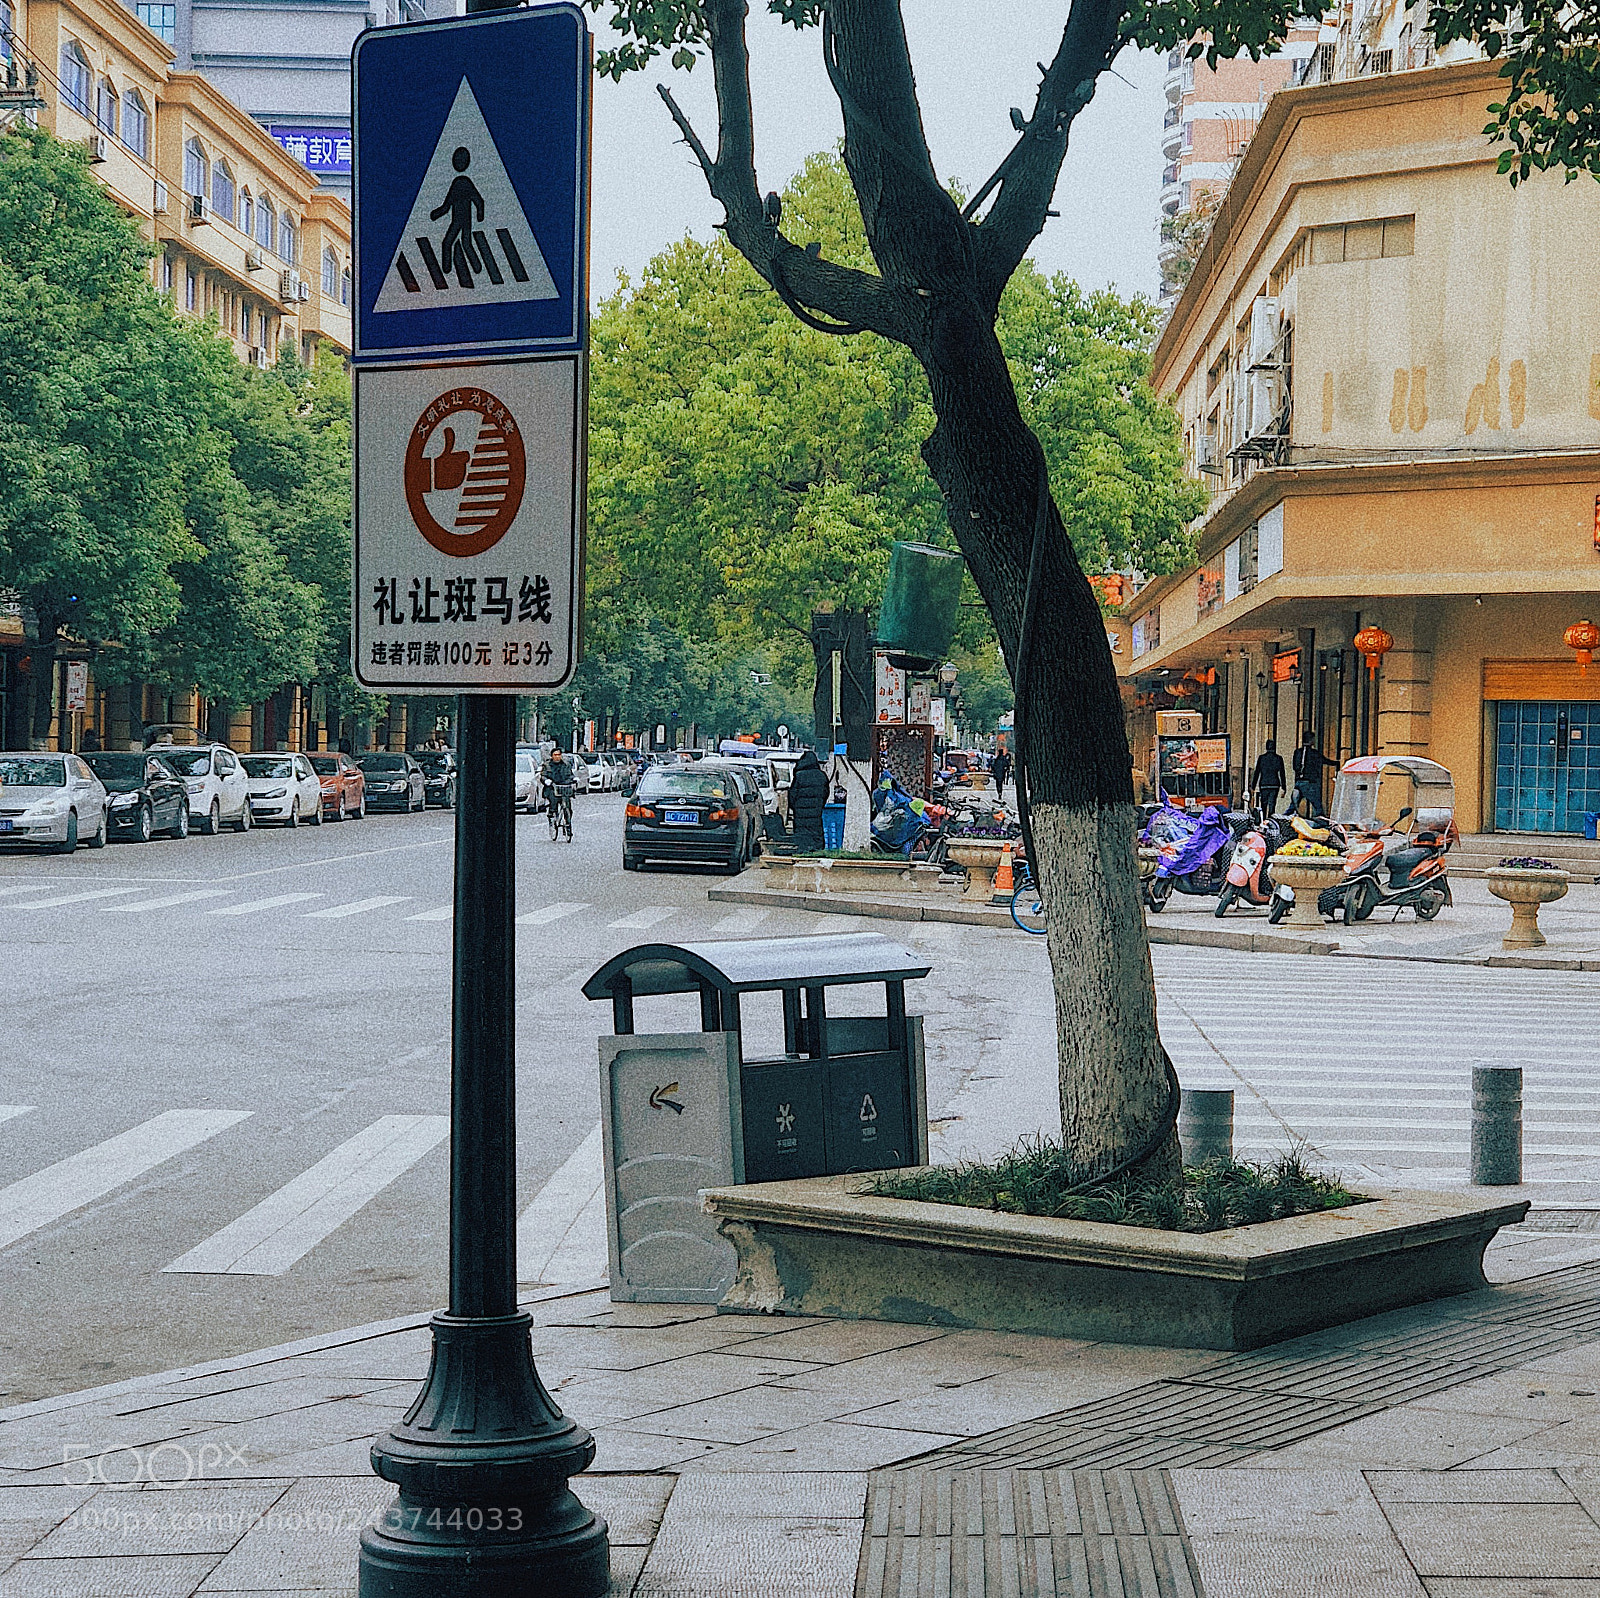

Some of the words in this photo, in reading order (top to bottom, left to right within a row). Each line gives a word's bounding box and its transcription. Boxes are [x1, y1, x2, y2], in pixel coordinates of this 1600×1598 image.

[417, 391, 464, 439] 文明礼让
[372, 575, 553, 626] 礼让斑马线
[370, 641, 492, 666] 违者罚款100元
[502, 641, 553, 666] 记3分
